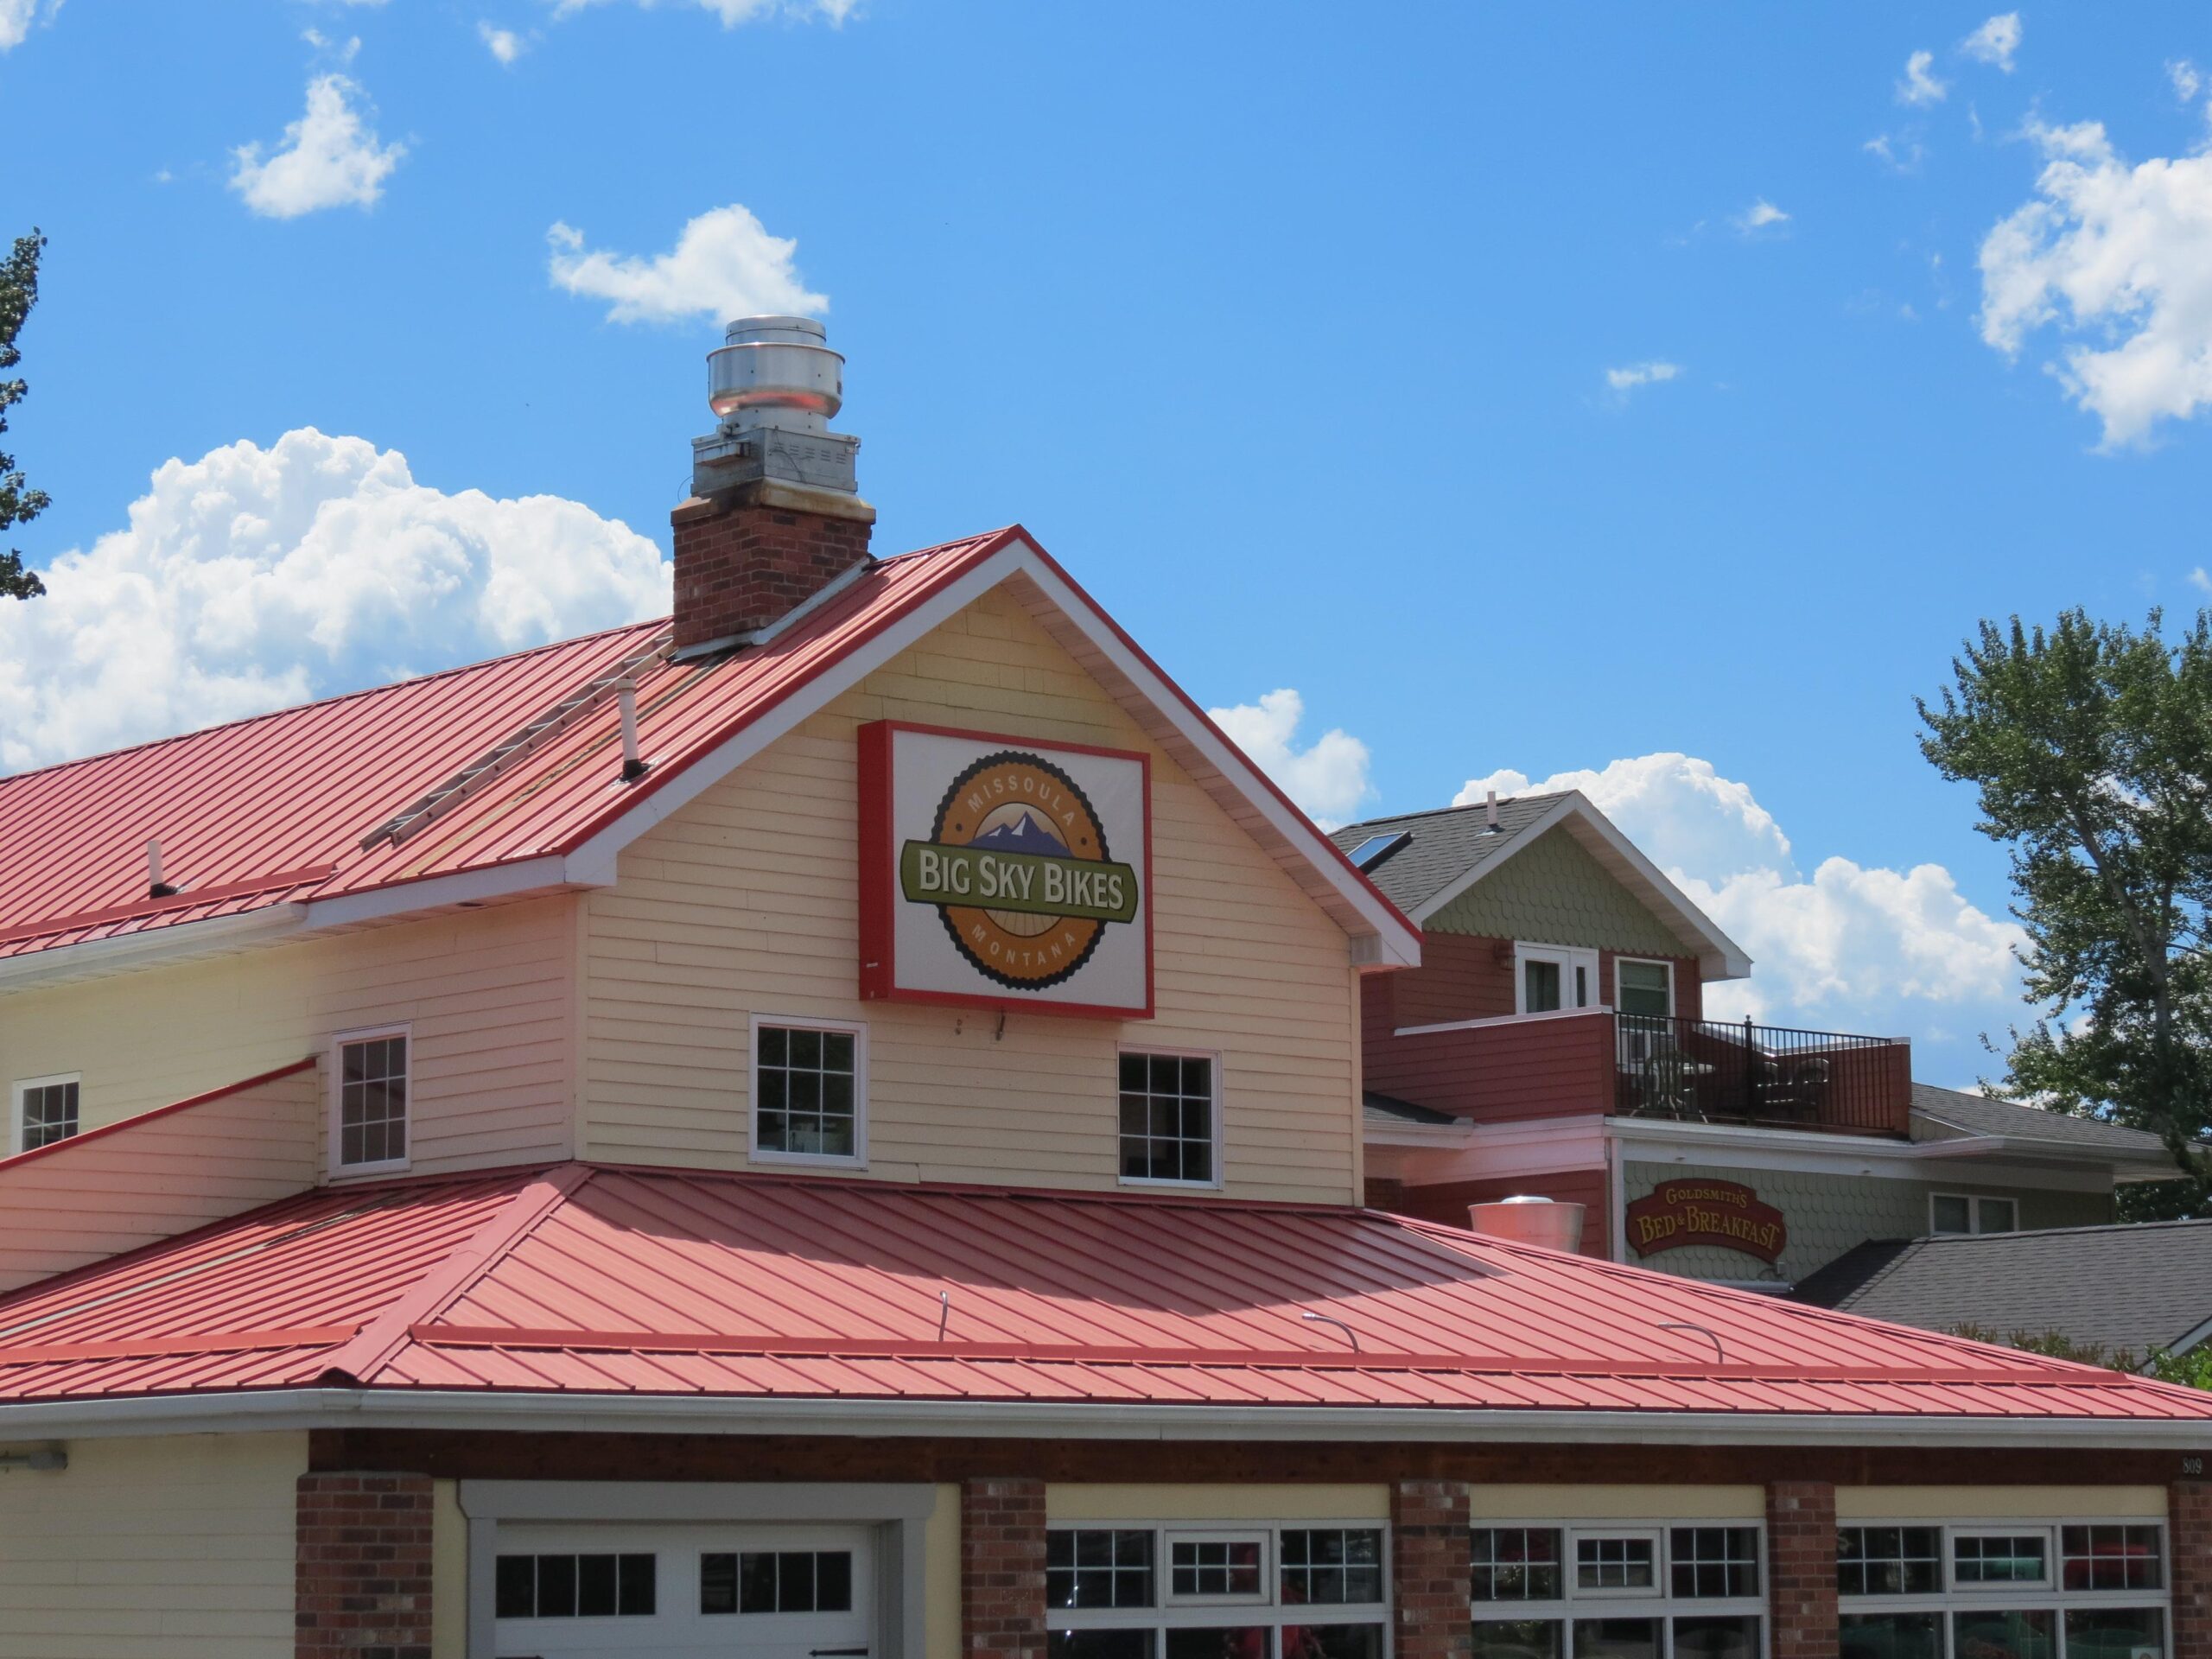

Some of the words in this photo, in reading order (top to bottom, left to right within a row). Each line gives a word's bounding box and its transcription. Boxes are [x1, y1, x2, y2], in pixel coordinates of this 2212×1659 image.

[967, 775, 1075, 826] MISSOULA
[918, 849, 970, 893] BIG
[980, 855, 1035, 899] SKY
[1044, 862, 1124, 910] BIKES
[972, 925, 1075, 966] MONTANA
[1666, 1188, 1747, 1208] GOLDSMITH'S
[1637, 1215, 1675, 1244] BED
[1677, 1213, 1685, 1226] &
[1686, 1205, 1779, 1249] BREAKFAST
[2183, 1457, 2202, 1474] 809
